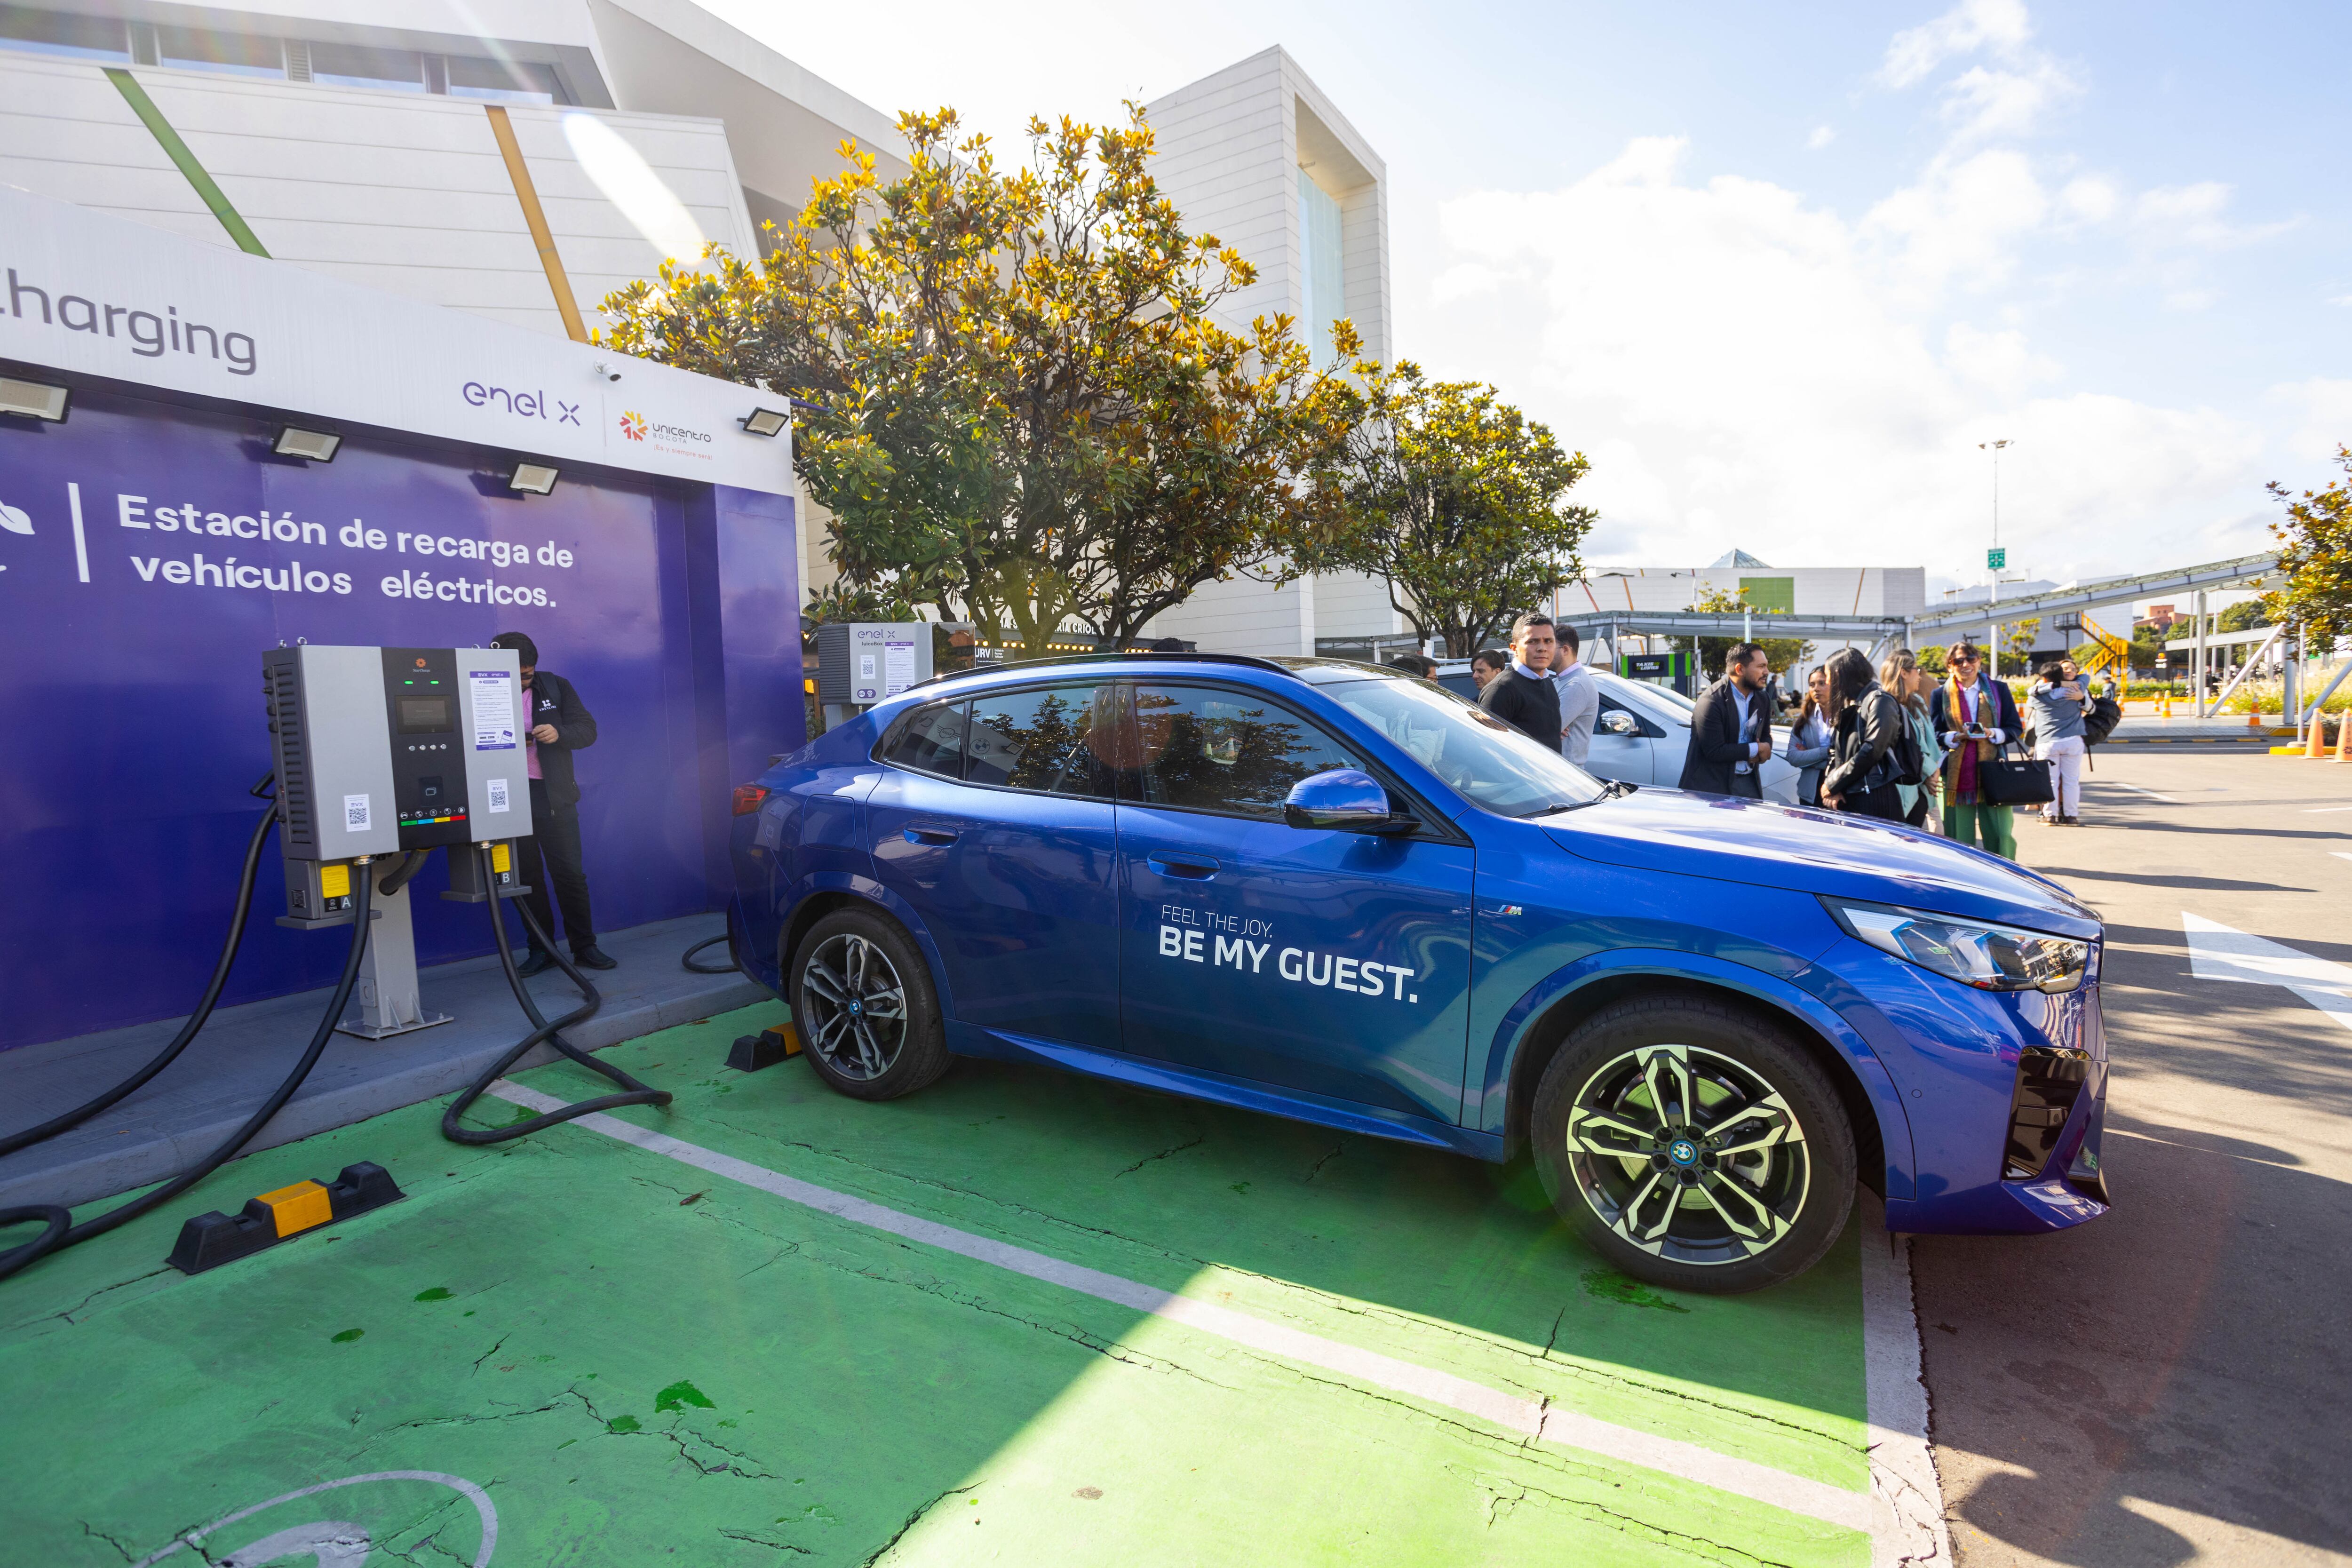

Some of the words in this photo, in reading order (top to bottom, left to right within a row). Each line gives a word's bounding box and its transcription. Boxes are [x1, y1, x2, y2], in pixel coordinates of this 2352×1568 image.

[0, 267, 257, 375] harging
[462, 381, 547, 420] enel
[671, 448, 696, 457] siempre
[118, 493, 326, 546] Estación
[339, 518, 388, 550] de
[397, 531, 530, 568] recarga
[536, 540, 574, 568] de
[131, 553, 352, 595] vehículos
[381, 570, 557, 608] eléctricos.
[858, 629, 884, 638] enel
[975, 648, 991, 658] URV
[502, 873, 510, 883] B
[342, 897, 351, 908] A
[1161, 904, 1200, 926] FEEL
[1205, 912, 1238, 932] THE
[1241, 919, 1272, 939] JOY.
[1159, 924, 1205, 963] BE
[1214, 935, 1271, 974] MY
[1279, 947, 1418, 1003] GUEST.
